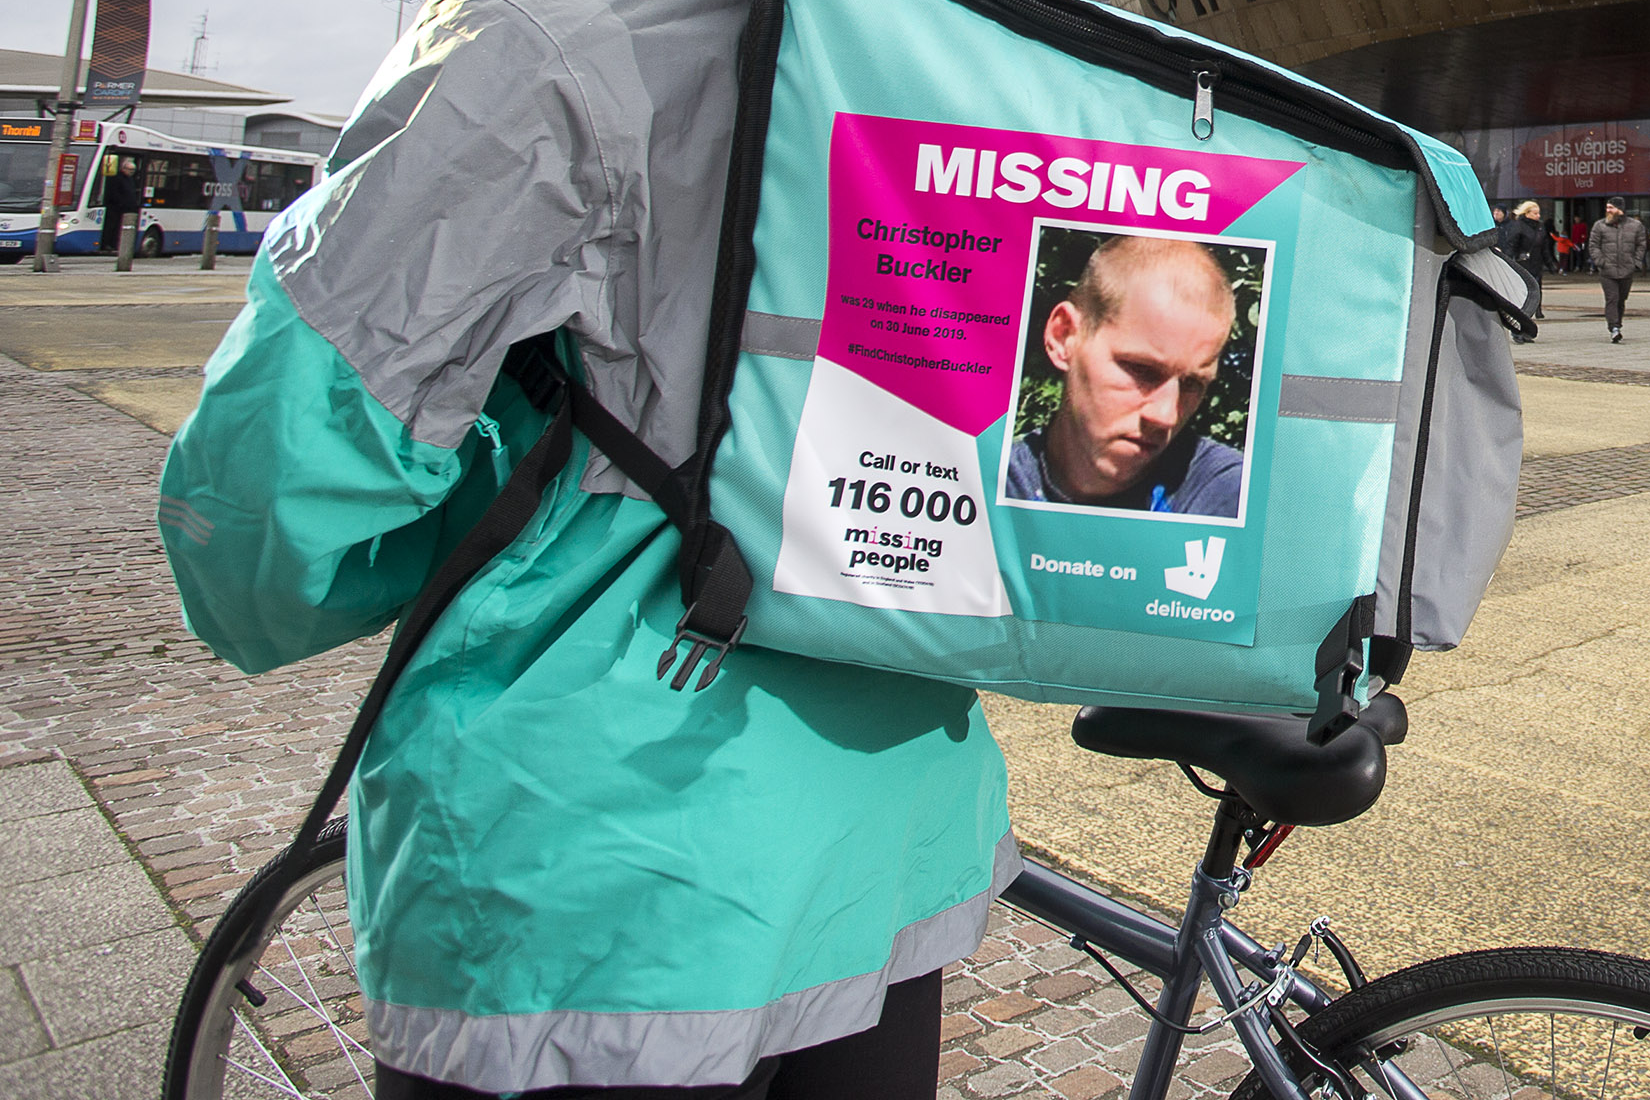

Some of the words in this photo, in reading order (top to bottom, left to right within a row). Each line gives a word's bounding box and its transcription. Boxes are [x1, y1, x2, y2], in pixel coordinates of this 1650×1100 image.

[2, 124, 41, 137] Thornhill
[1544, 140, 1572, 158] Les
[1574, 137, 1627, 159] vêpres
[1545, 157, 1625, 177] siciliennes
[202, 181, 233, 198] cross
[914, 143, 1211, 221] MISSING
[857, 218, 1002, 253] Christopher
[876, 254, 972, 283] Buckler
[841, 294, 860, 307] was
[862, 297, 874, 309] 29
[877, 301, 906, 315] when
[910, 305, 926, 317] he
[930, 308, 1010, 326] disappeared
[870, 319, 883, 329] on
[886, 320, 899, 332] 30
[902, 323, 930, 337] June
[933, 327, 967, 340] 2019.
[848, 343, 992, 375] #FindChristopherBuckler
[859, 451, 896, 471] Call
[900, 460, 920, 474] or
[925, 462, 959, 482] text
[828, 477, 892, 514] 116
[900, 486, 977, 526] 000
[844, 526, 943, 557] missing
[849, 550, 930, 573] people
[1030, 553, 1104, 577] Donate
[1110, 565, 1137, 581] on
[1145, 599, 1235, 623] deliveroo
